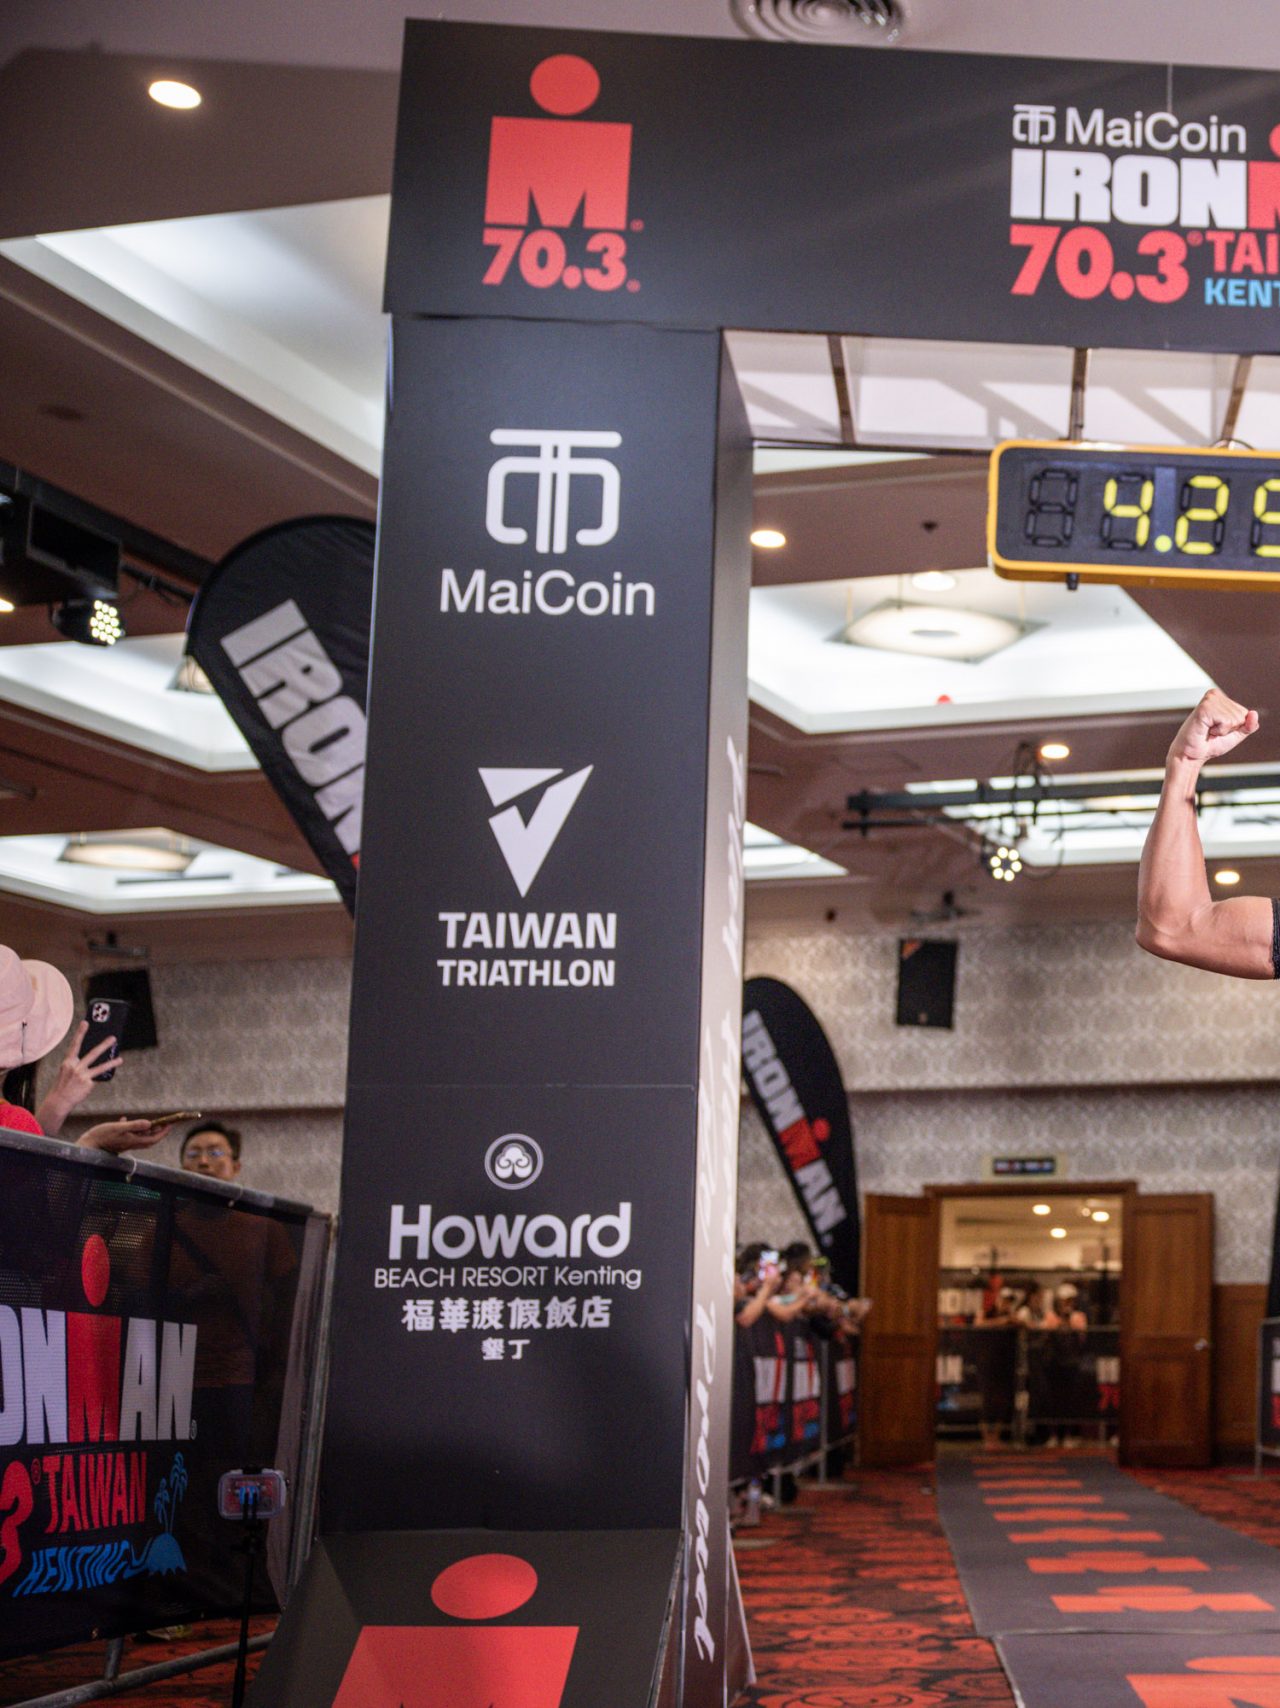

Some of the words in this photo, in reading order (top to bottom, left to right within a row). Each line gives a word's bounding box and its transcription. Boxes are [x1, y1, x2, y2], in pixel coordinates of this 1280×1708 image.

[1065, 107, 1247, 153] MaiCoin
[482, 228, 628, 292] 70.3
[1010, 224, 1190, 303] 70.3
[439, 568, 656, 616] MaiCoin
[438, 912, 617, 949] TAIWAN
[437, 960, 615, 987] TRIATHLON
[742, 1010, 847, 1235] IRONMAN
[388, 1202, 632, 1260] Howard
[374, 1266, 456, 1288] BEACH
[461, 1266, 549, 1287] RESORT
[554, 1265, 642, 1290] Kenting
[401, 1297, 612, 1333] 福華渡假飯店
[481, 1337, 530, 1361] 墾丁
[42, 1452, 148, 1534] TAIWAN
[12, 1540, 140, 1598] KENTING
